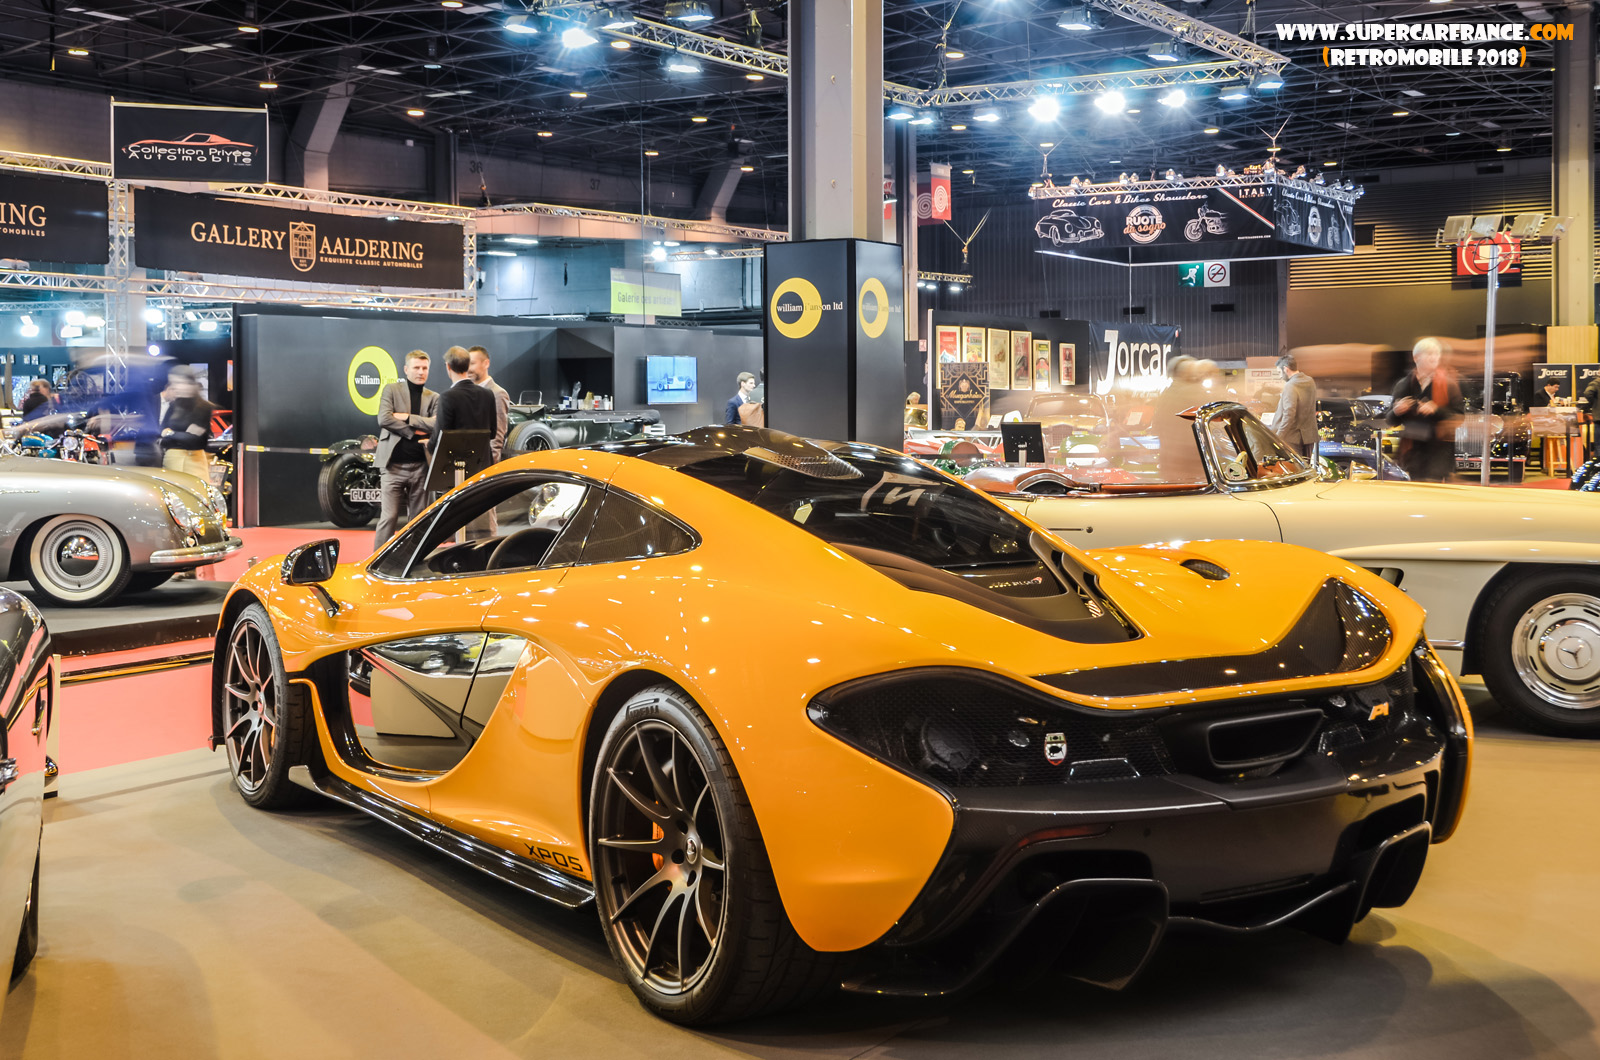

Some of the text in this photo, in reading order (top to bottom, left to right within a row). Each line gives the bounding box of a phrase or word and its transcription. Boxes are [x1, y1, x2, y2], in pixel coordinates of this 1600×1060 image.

[128, 145, 252, 158] Collection Privée
[128, 152, 252, 163] Automobile
[590, 178, 600, 191] 37
[1239, 187, 1273, 196] ITALY
[1114, 194, 1121, 204] &
[0, 202, 47, 227] ING
[1126, 216, 1163, 226] RUOTE
[0, 227, 46, 237] OMOBILES
[1123, 222, 1166, 235] da sogno
[190, 221, 424, 261] GALLERY AALDERING
[320, 256, 353, 265] EXQUISITE
[382, 261, 423, 269] AUTOMOBILES
[776, 303, 803, 312] william
[832, 301, 844, 311] ltd
[1096, 329, 1172, 395] Jorcar
[1537, 368, 1568, 379] Jorcar
[354, 375, 380, 385] william
[352, 490, 363, 501] GU
